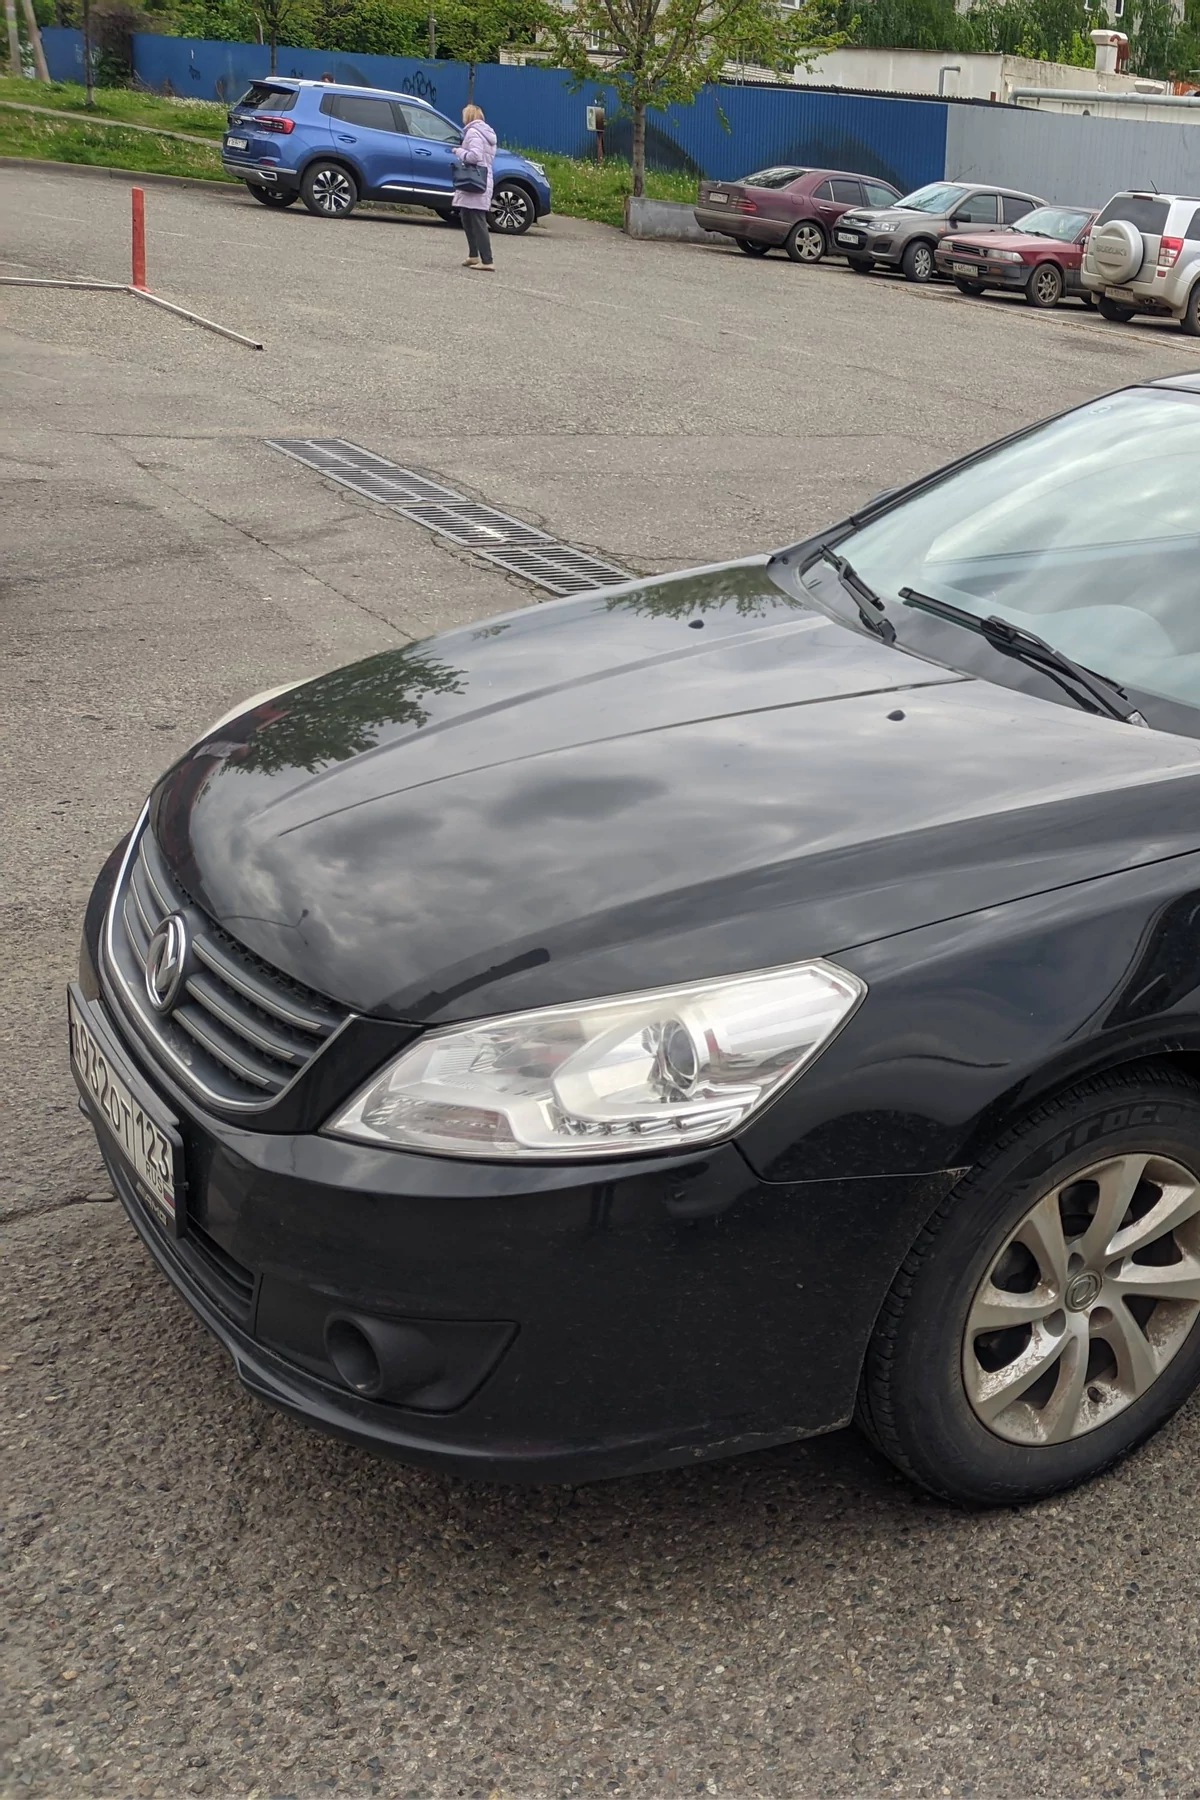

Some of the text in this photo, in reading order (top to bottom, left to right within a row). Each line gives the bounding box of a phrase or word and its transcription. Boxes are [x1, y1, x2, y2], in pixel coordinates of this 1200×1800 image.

[1096, 245, 1127, 256] SUZUKI
[135, 1111, 170, 1183] 123
[145, 1161, 163, 1194] RUS
